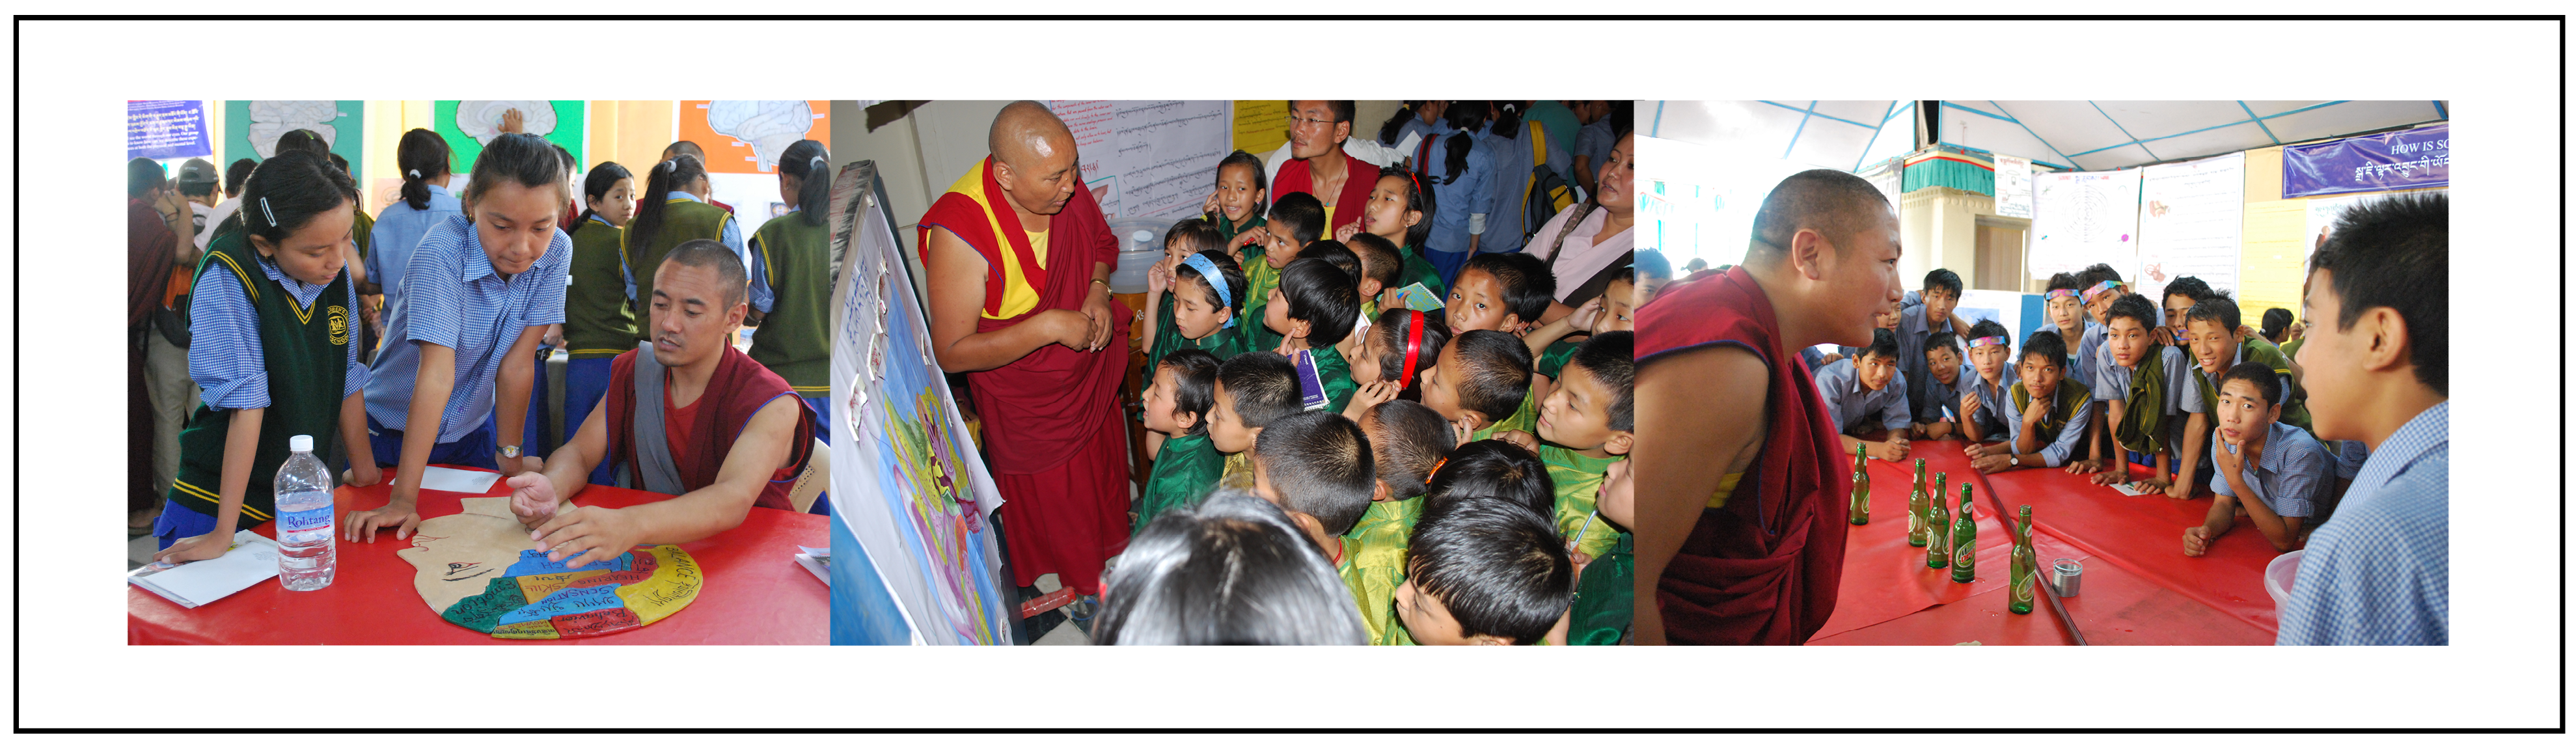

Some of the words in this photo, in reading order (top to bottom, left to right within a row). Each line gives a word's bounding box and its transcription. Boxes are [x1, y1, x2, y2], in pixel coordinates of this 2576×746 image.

[2391, 142, 2420, 155] HOW
[2422, 141, 2434, 151] IS
[288, 514, 331, 528] Rohtang
[540, 559, 612, 570] SPCH
[665, 547, 696, 580] BALANCE
[578, 573, 640, 585] HEARING
[525, 582, 566, 593] SKILL
[541, 586, 613, 605] SENSATION
[557, 609, 628, 623] Behavior
